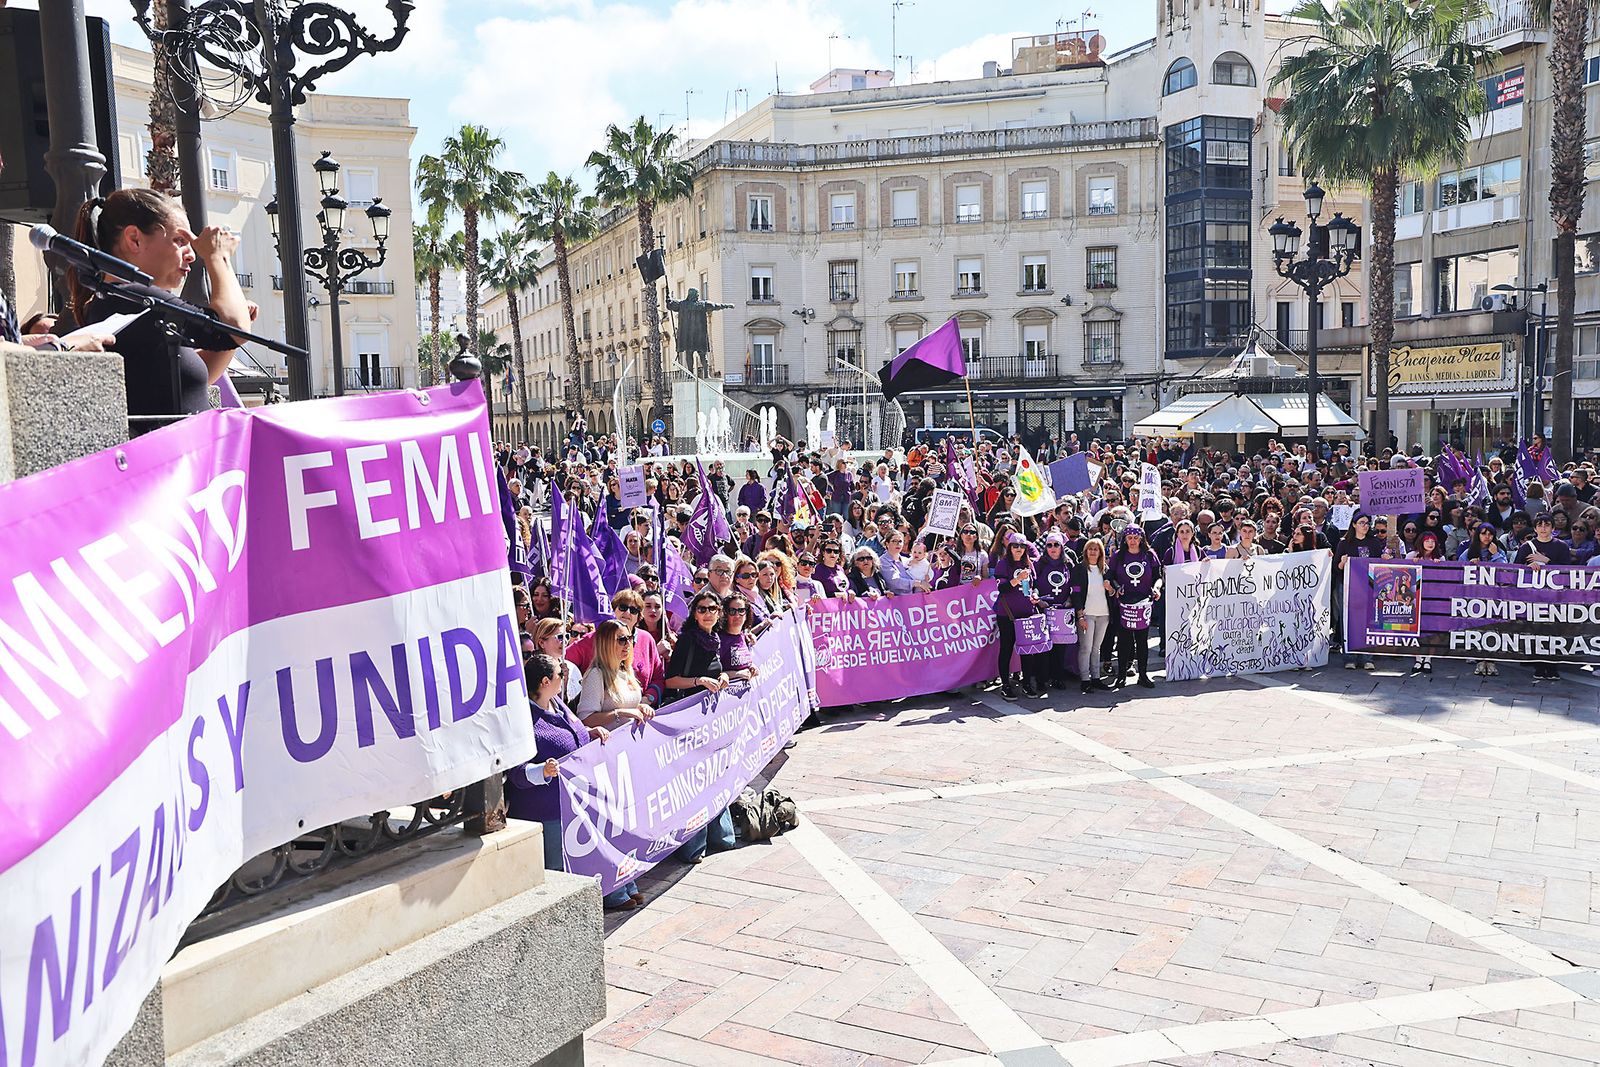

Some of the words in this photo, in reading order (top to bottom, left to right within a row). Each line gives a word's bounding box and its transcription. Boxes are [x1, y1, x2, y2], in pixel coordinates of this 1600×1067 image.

[1457, 347, 1501, 363] Plaza
[938, 499, 952, 507] 8M
[1369, 493, 1423, 506] ANTIFASCISTA
[1263, 575, 1273, 591] NI
[1463, 565, 1496, 586] EN
[812, 609, 904, 634] FEMINISMO
[908, 603, 939, 627] DE
[1382, 605, 1390, 615] EN
[1450, 597, 1600, 624] ROMPIENDO
[828, 634, 865, 652] PARA
[830, 653, 867, 669] DESDE
[870, 648, 922, 665] HUELVA
[923, 646, 942, 660] AL
[944, 633, 996, 656] MUNDO
[1365, 635, 1420, 647] HUELVA
[1449, 630, 1600, 656] FRONTERAS
[216, 681, 251, 793] Y
[275, 613, 527, 763] UNIDA
[654, 723, 711, 769] MUJERES
[645, 747, 729, 829] FEMINISMO
[564, 750, 637, 858] 8M
